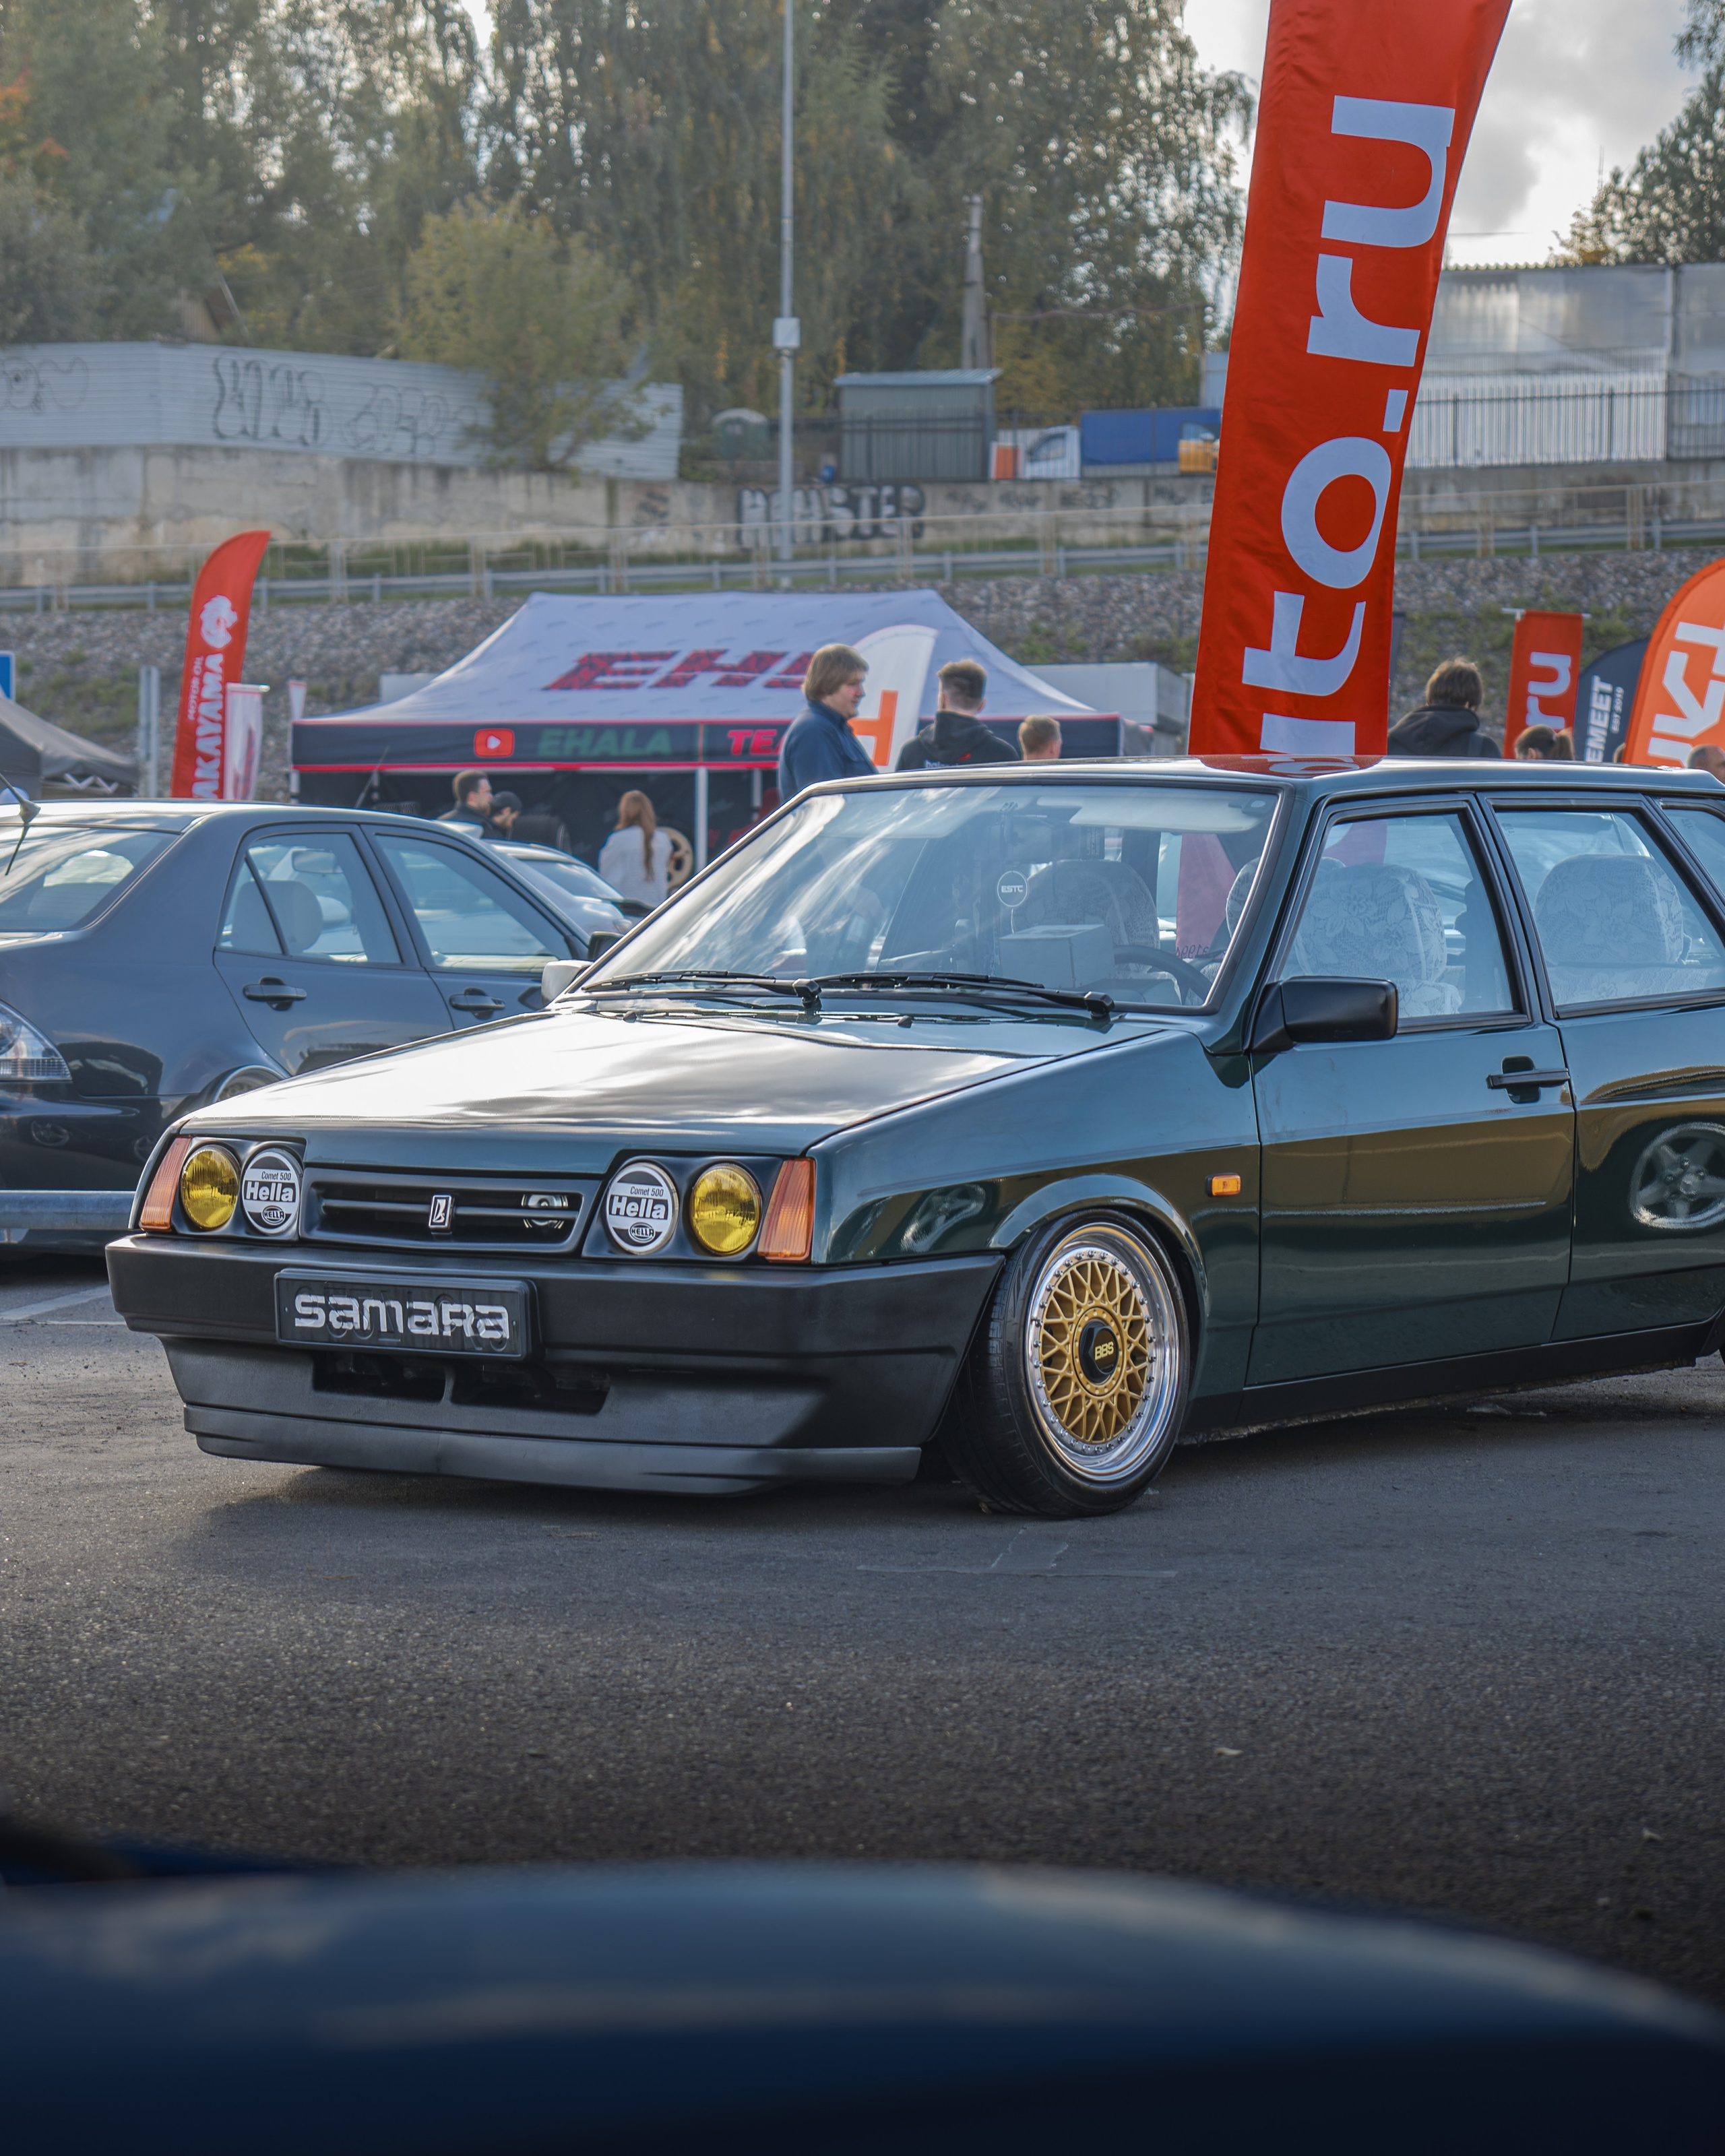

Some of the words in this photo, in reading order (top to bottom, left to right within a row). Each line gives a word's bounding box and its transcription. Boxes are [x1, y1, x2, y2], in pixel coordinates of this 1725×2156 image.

[193, 655, 203, 676] OIL
[187, 676, 200, 721] MOTOR
[191, 653, 224, 800] AKAYAMA
[538, 728, 672, 756] EHALA
[727, 730, 784, 756] TE
[1001, 885, 1024, 893] ESTC
[261, 1171, 278, 1180] Comet
[280, 1172, 291, 1181] 500
[246, 1181, 294, 1202] Hella
[630, 1186, 650, 1196] Comet
[651, 1188, 664, 1197] 500
[263, 1210, 284, 1219] HELLA
[611, 1195, 666, 1219] Hella
[631, 1226, 654, 1237] HELLA
[1094, 1341, 1115, 1360] BBS
